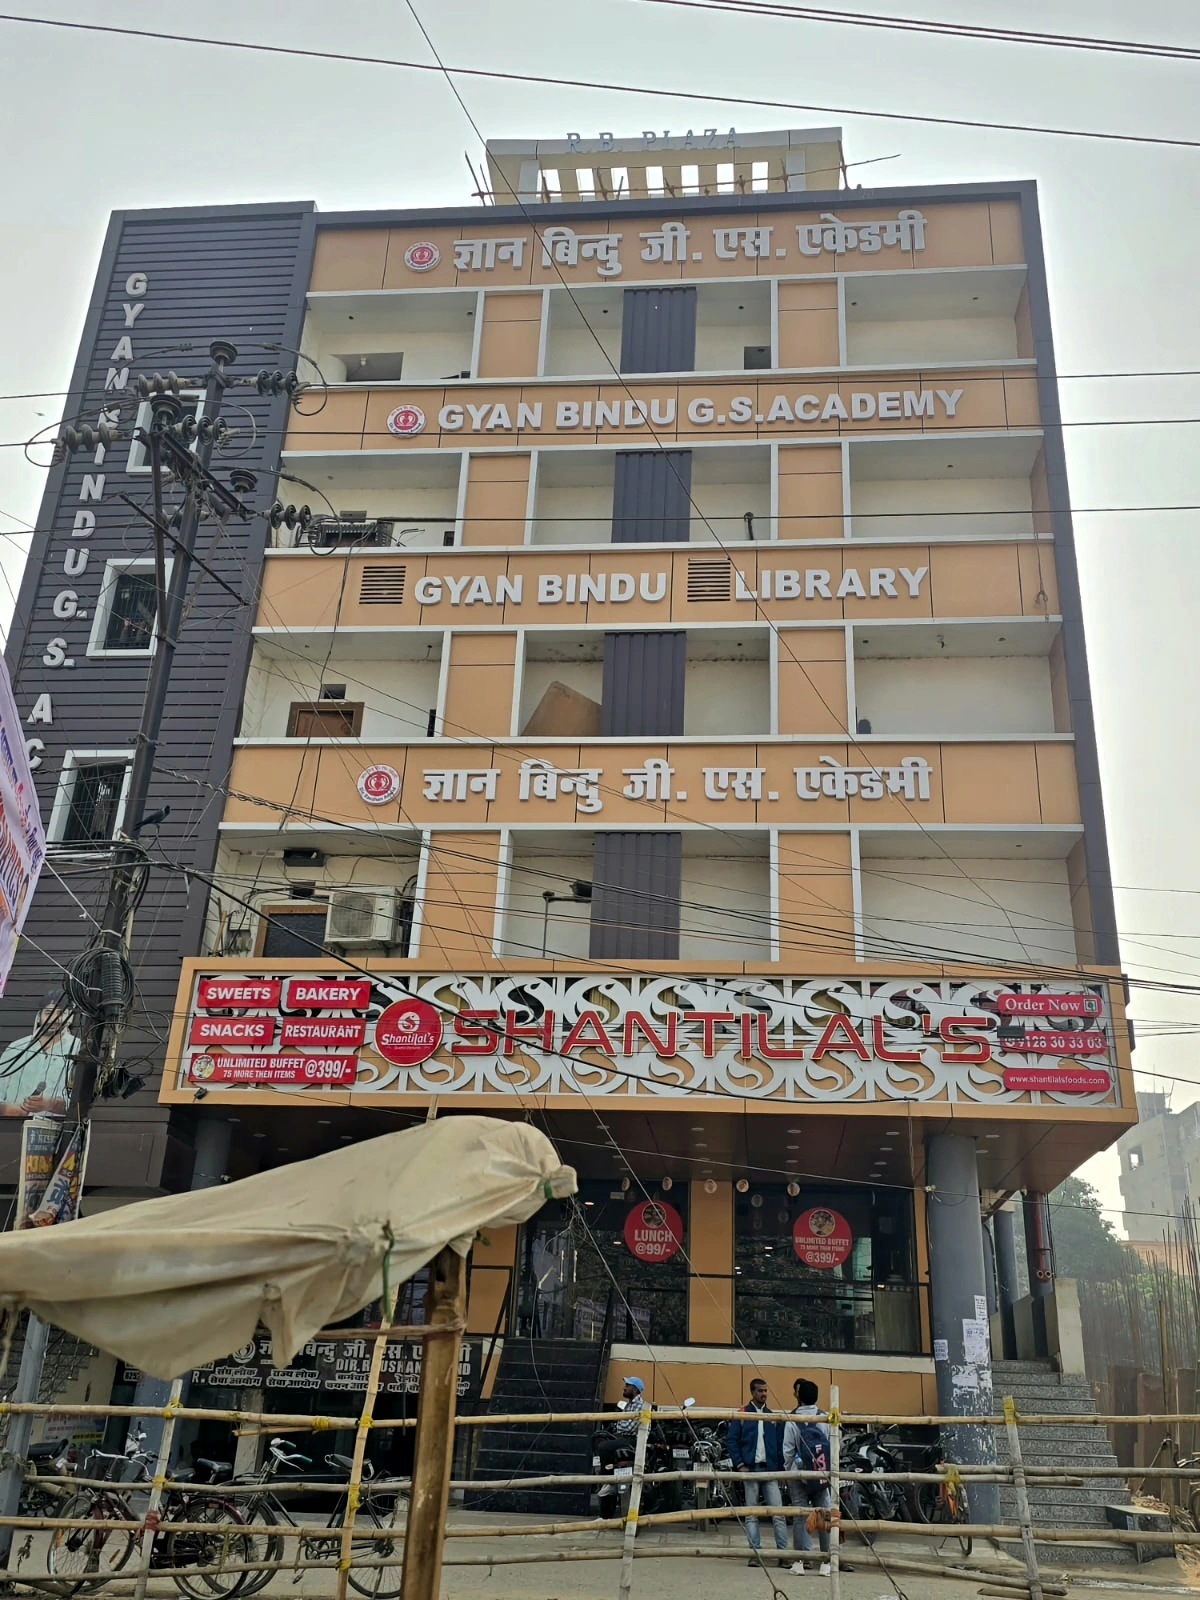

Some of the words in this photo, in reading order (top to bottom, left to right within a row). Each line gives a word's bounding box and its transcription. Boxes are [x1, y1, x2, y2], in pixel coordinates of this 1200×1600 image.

[453, 237, 527, 272] ज्ञान
[541, 226, 623, 278] बिन्दु
[795, 209, 928, 256] एकेडमी
[437, 402, 542, 432] GYAN
[555, 398, 676, 429] BINDU
[414, 574, 523, 605] GYAN
[537, 572, 667, 605] BINDU
[735, 566, 929, 600] LIBRARY
[422, 768, 501, 802] ज्ञान
[518, 758, 604, 814] बिन्दु
[793, 755, 934, 801] एकेडमी
[206, 986, 272, 1001] SWEETS
[295, 986, 362, 1001] BAKERY
[1004, 998, 1045, 1011] Order
[1048, 998, 1081, 1012] Now
[200, 1023, 265, 1038] SNACKS
[285, 1024, 362, 1039] RESTAURANT
[451, 1008, 992, 1064] SHANTILAL'S
[381, 1032, 435, 1046] Shantilal's
[1050, 1036, 1065, 1048] 30
[1069, 1036, 1084, 1049] 33
[217, 1057, 268, 1069] UNLIMITED
[269, 1058, 306, 1070] BUFFET
[305, 1059, 352, 1079] @399/-
[223, 1070, 232, 1079] 75
[233, 1070, 254, 1079] MORE
[255, 1070, 273, 1079] THEN
[274, 1070, 296, 1079] ITEMS
[634, 1229, 673, 1242] LUNCH
[635, 1242, 671, 1256] @99/-
[806, 1250, 840, 1264] @399/-
